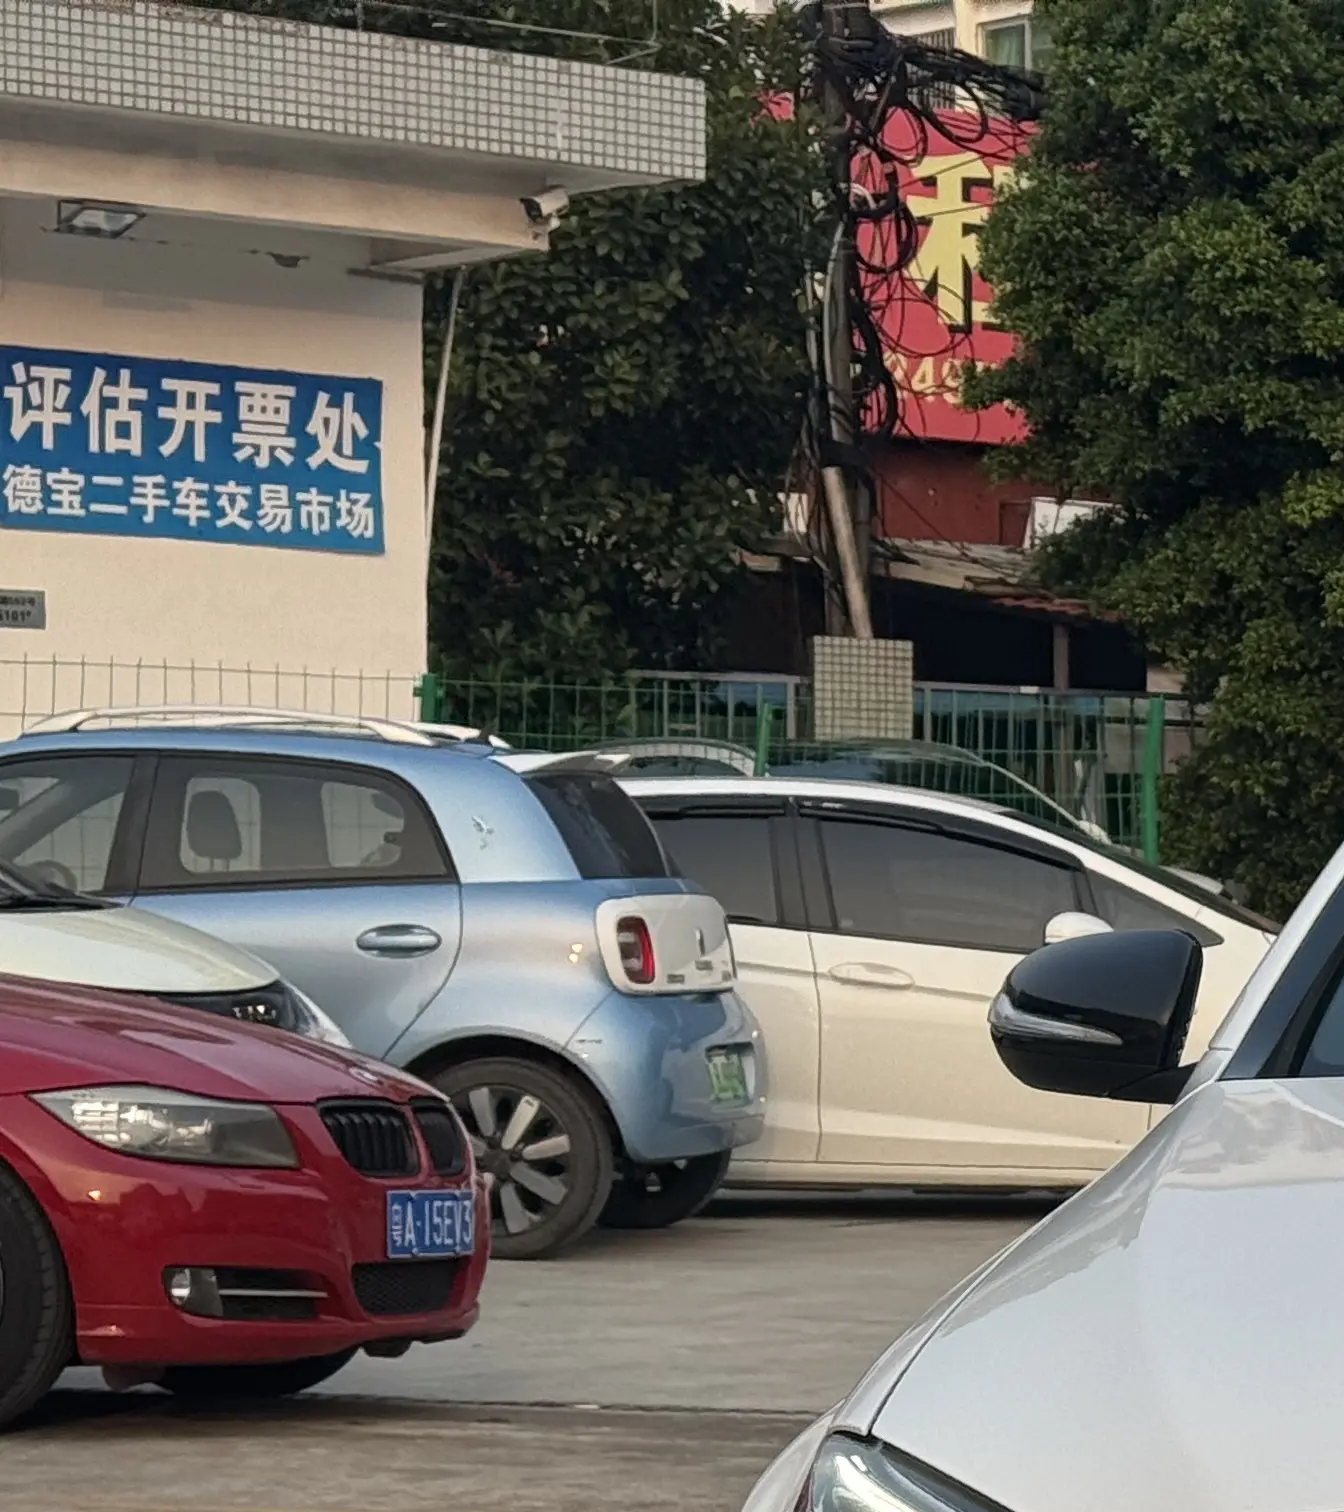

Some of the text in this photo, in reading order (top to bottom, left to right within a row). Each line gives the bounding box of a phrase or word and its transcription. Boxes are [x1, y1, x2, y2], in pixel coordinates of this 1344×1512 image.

[3, 360, 371, 474] 评估开票处
[2, 463, 375, 540] 德宝二手车交易市场
